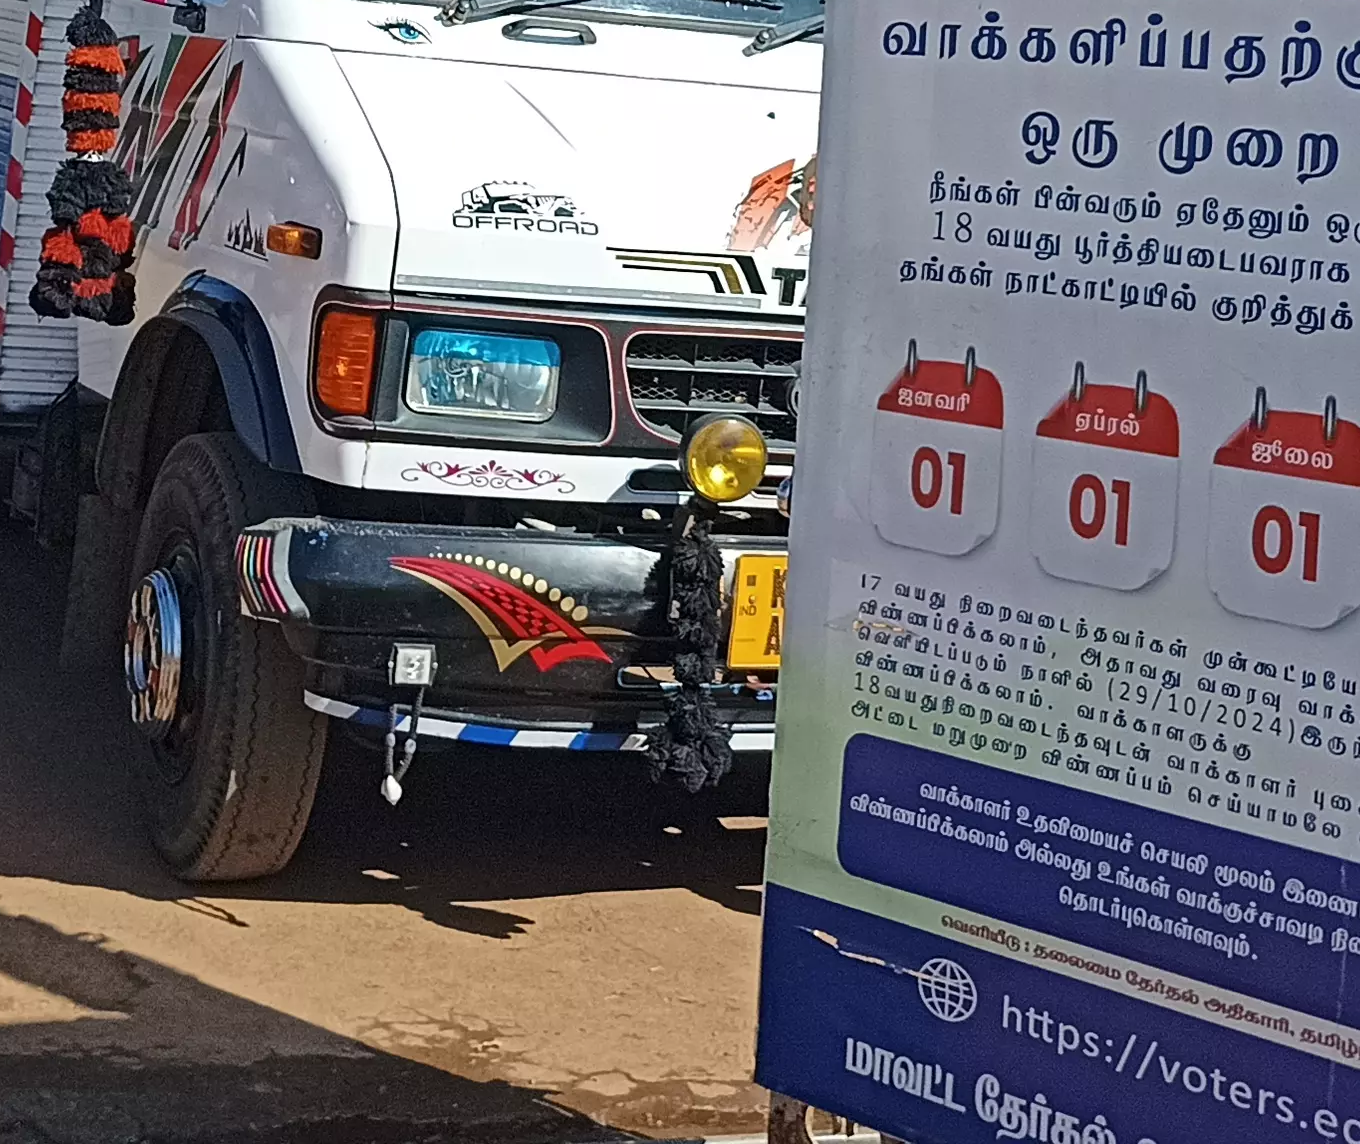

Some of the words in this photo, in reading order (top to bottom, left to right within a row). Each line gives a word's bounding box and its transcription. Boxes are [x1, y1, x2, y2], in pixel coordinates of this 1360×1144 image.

[1022, 112, 1117, 168] ஒரு
[1159, 122, 1338, 184] முறை
[452, 213, 600, 236] OFFROAD
[930, 171, 1020, 206] நீங்கள்
[1035, 185, 1161, 223] பின்வரும்
[1176, 197, 1309, 239] ஏதேனும்
[933, 211, 972, 243] 18
[986, 221, 1062, 260] வயது
[1075, 231, 1349, 287] பூர்த்தியடைபவராக
[900, 256, 993, 287] தங்கள்
[1006, 272, 1196, 311] நாட்காட்டியில்
[1212, 294, 1353, 335] குறித்துக்
[897, 386, 972, 413] ஜனவரி
[1075, 407, 1141, 438] ஏப்ரல்
[912, 447, 965, 515] 01
[1250, 438, 1335, 472] ஜூலை
[1070, 474, 1130, 546] 01
[1252, 505, 1320, 582] 01
[858, 598, 1057, 660] விண்ணப்பிக்கலாம்,
[1080, 646, 1181, 692] அதாவது
[1197, 674, 1282, 715] வரைவு
[858, 625, 1009, 674] வெளியிடப்படும்
[1021, 665, 1092, 693] நாளில்
[862, 574, 881, 590] 17
[895, 584, 945, 610] வயது
[960, 595, 1187, 664] நிறைவடைந்தவர்கள்
[1198, 651, 1356, 698] முன்கூட்டியே
[855, 648, 1052, 717] விண்ணப்பிக்கலாம்.
[1075, 697, 1251, 765] வாக்காளருக்கு
[852, 700, 917, 730] அட்டை
[933, 723, 1026, 760] மறுமுறை
[1042, 746, 1171, 794] விண்ணப்பம்
[1186, 784, 1343, 842] செய்யாமலே
[1168, 755, 1296, 803] வாக்காளர்
[849, 794, 1009, 855] விண்ணப்பிக்கலாம்
[1015, 836, 1095, 882] அல்லது
[1097, 859, 1171, 900] உங்கள்
[1176, 884, 1325, 947] வாக்குச்சாவடி
[919, 781, 1013, 822] வாக்காளர்
[1016, 806, 1135, 857] உதவிமையச்
[1140, 841, 1210, 877] செயலி
[1214, 868, 1276, 897] மூலம்
[1033, 942, 1122, 982] தலைமை
[1125, 964, 1200, 1008] தேர்தல்
[844, 1036, 967, 1114] மாவட்ட
